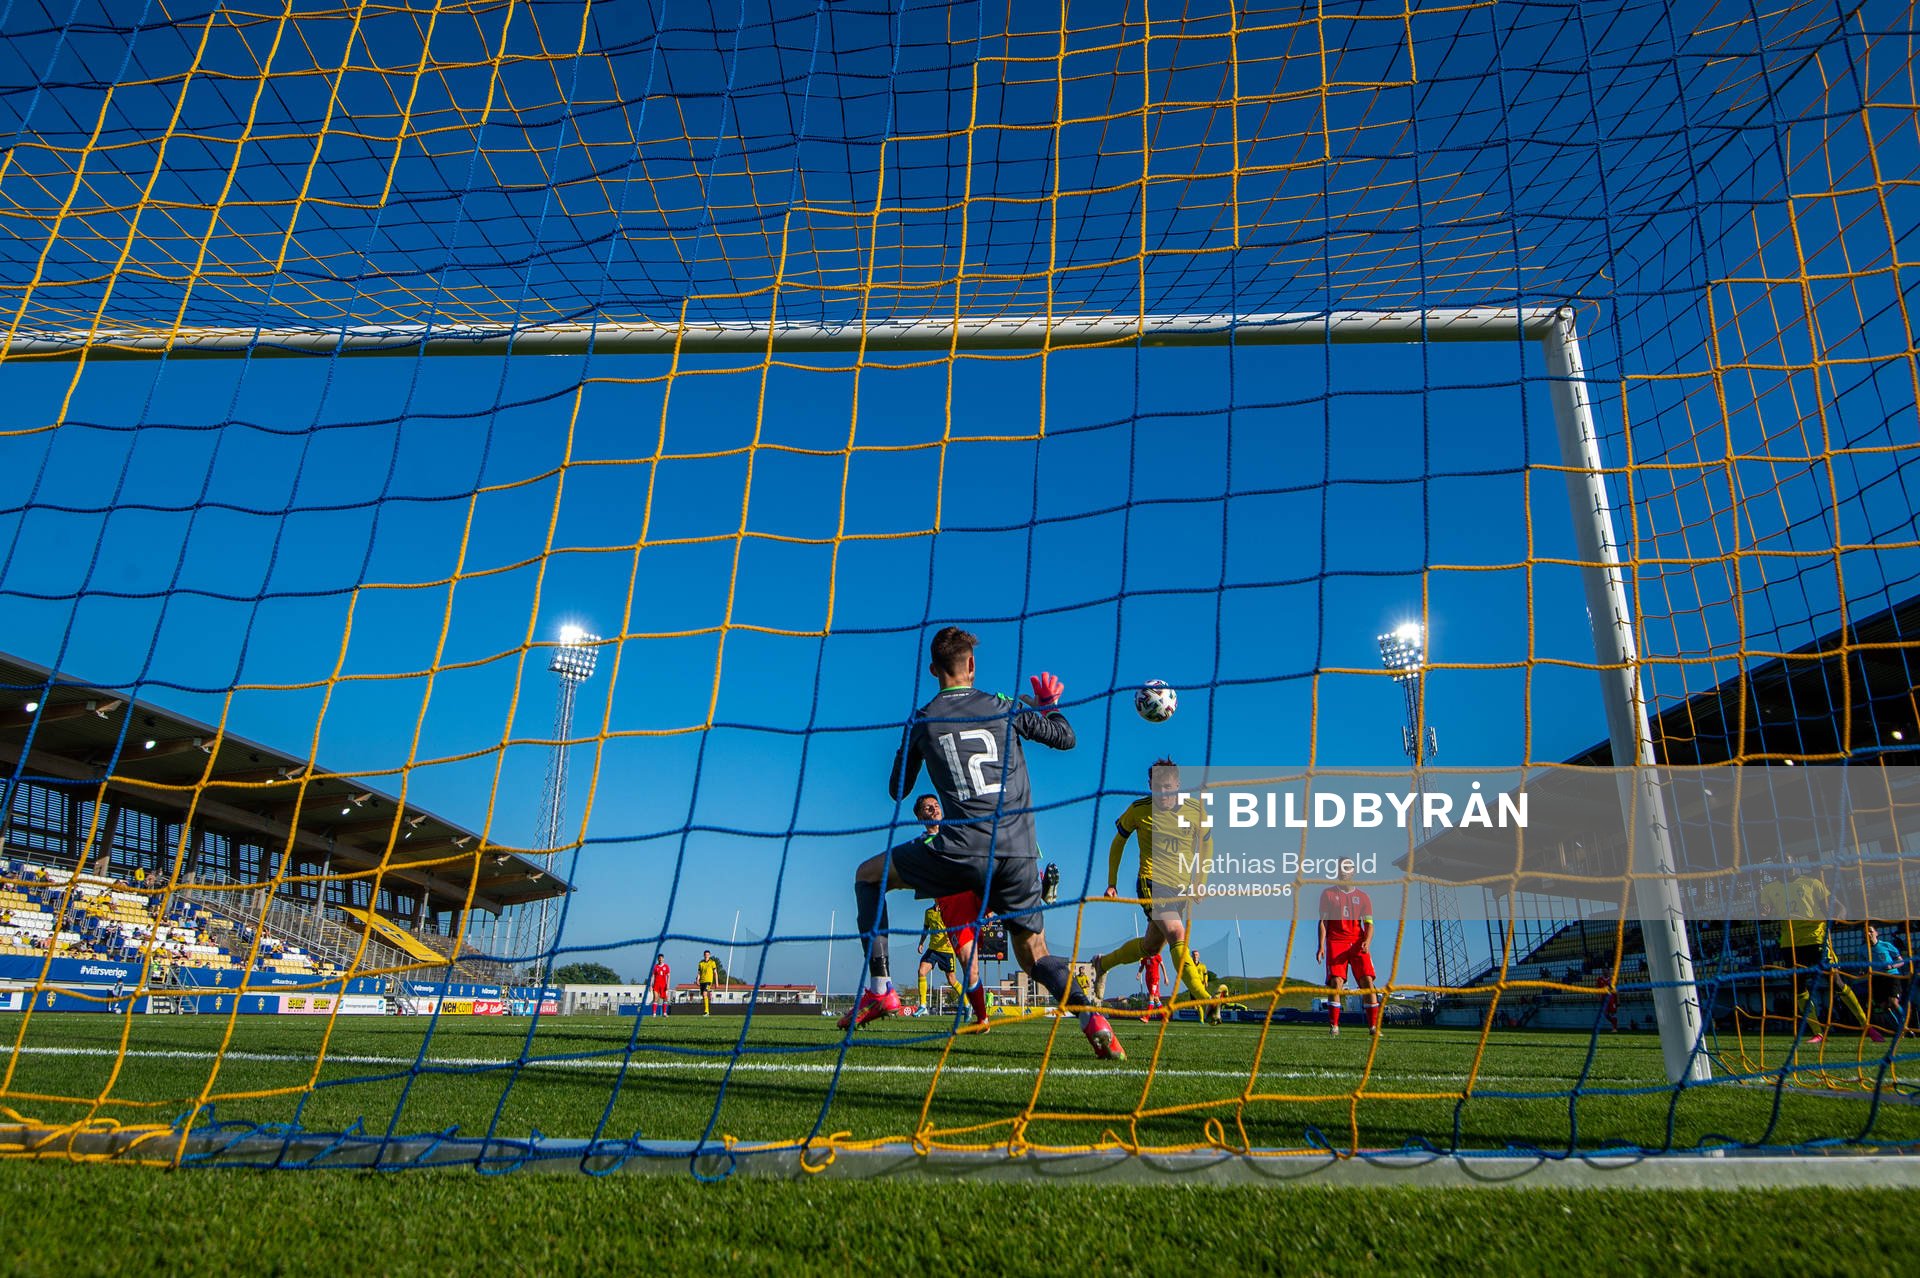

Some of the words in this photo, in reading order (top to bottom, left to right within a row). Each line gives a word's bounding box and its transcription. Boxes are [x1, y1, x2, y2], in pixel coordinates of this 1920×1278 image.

[939, 729, 1006, 801] 12
[1164, 838, 1179, 853] 20
[1342, 905, 1350, 918] 6
